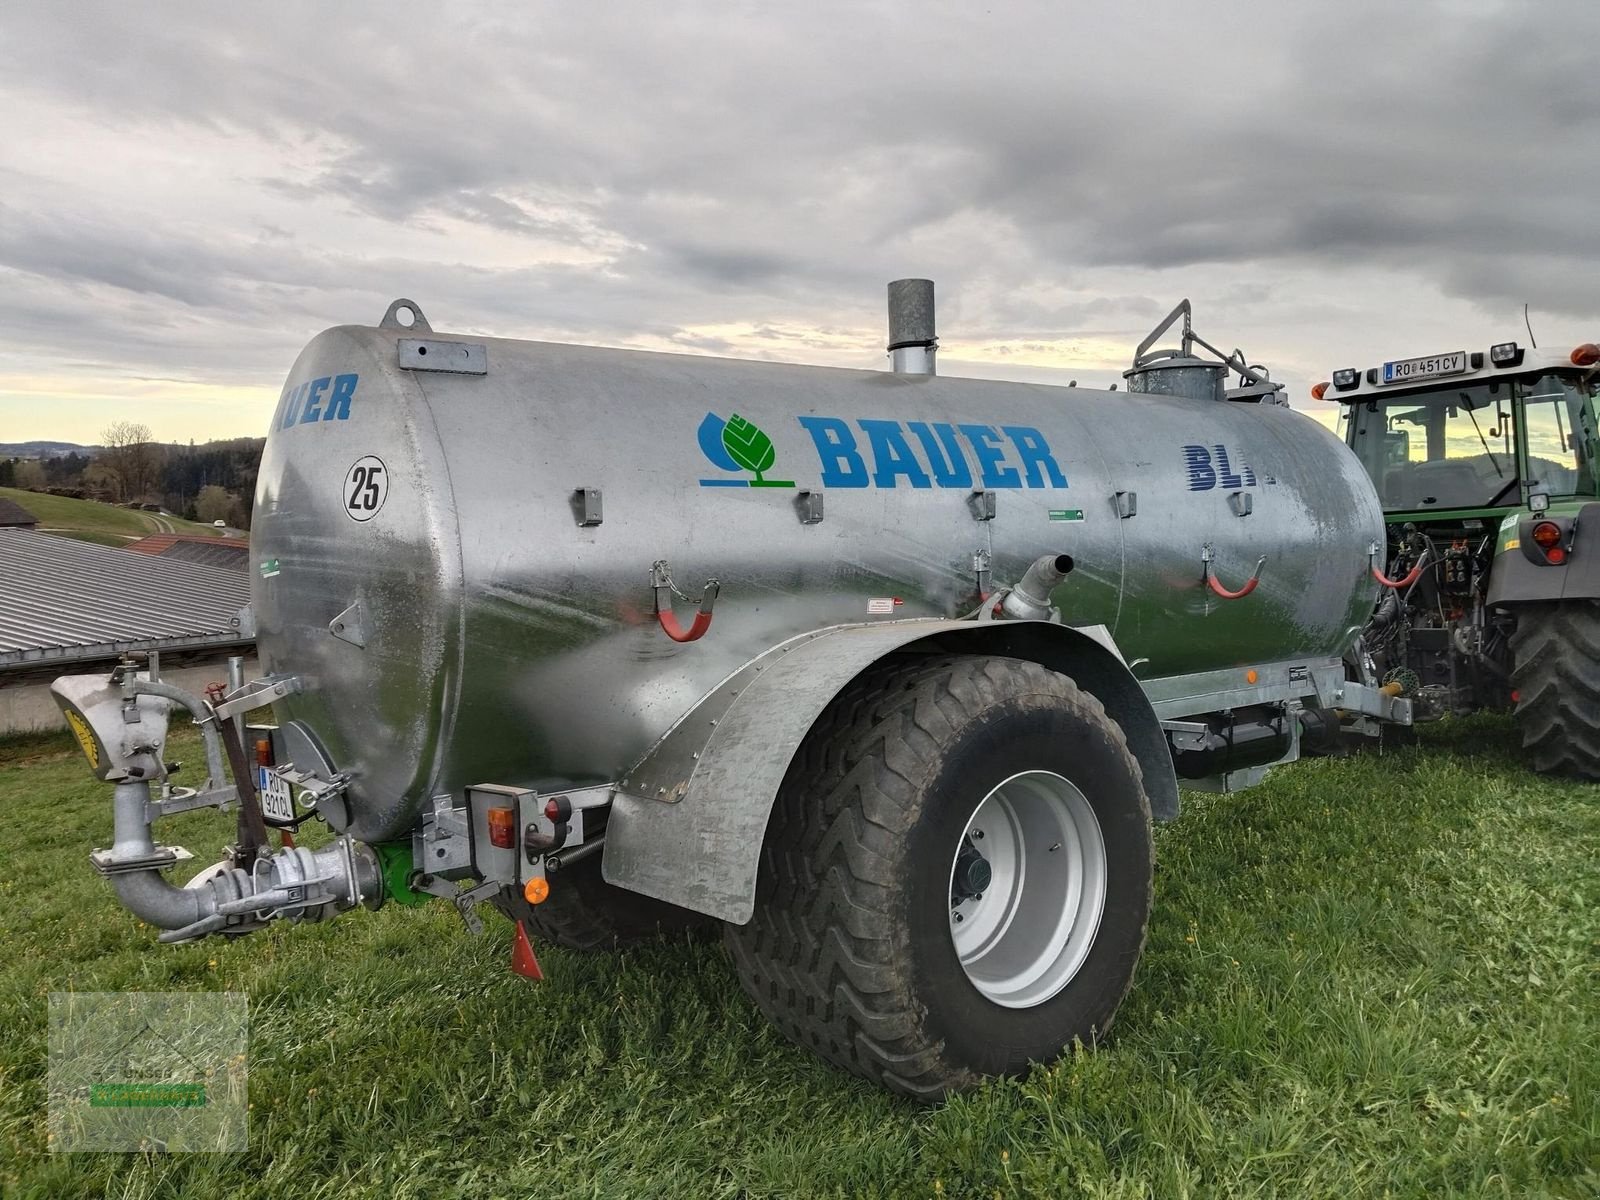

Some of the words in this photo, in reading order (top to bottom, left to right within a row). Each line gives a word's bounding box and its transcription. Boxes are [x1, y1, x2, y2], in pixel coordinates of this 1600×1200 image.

[1396, 363, 1410, 376] RO
[276, 373, 359, 433] UER
[797, 415, 1069, 489] BAUER
[349, 466, 382, 511] 25
